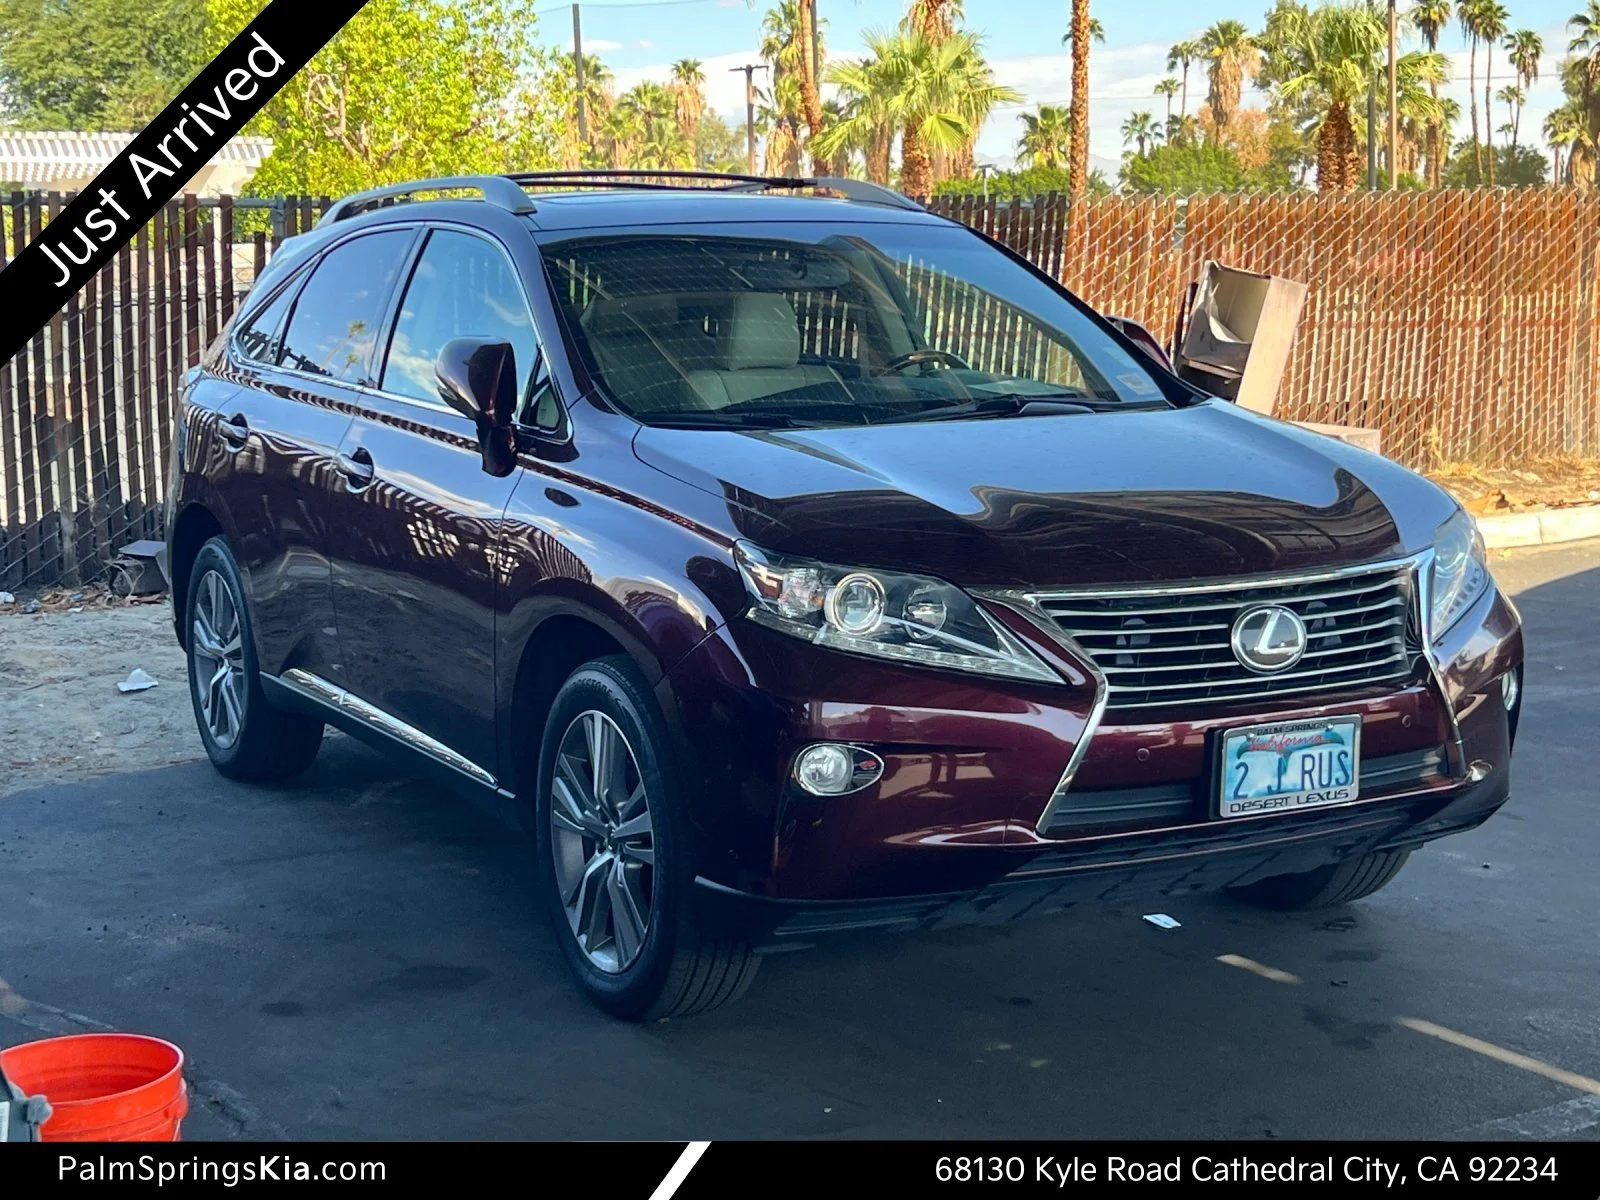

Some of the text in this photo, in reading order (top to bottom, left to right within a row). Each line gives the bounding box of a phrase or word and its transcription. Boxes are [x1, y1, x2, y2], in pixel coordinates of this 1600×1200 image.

[1256, 722, 1327, 736] PALM SPRINGS
[1233, 761, 1249, 800] 2
[1300, 750, 1350, 792] RUS
[1230, 788, 1349, 814] DESERT LEXUS
